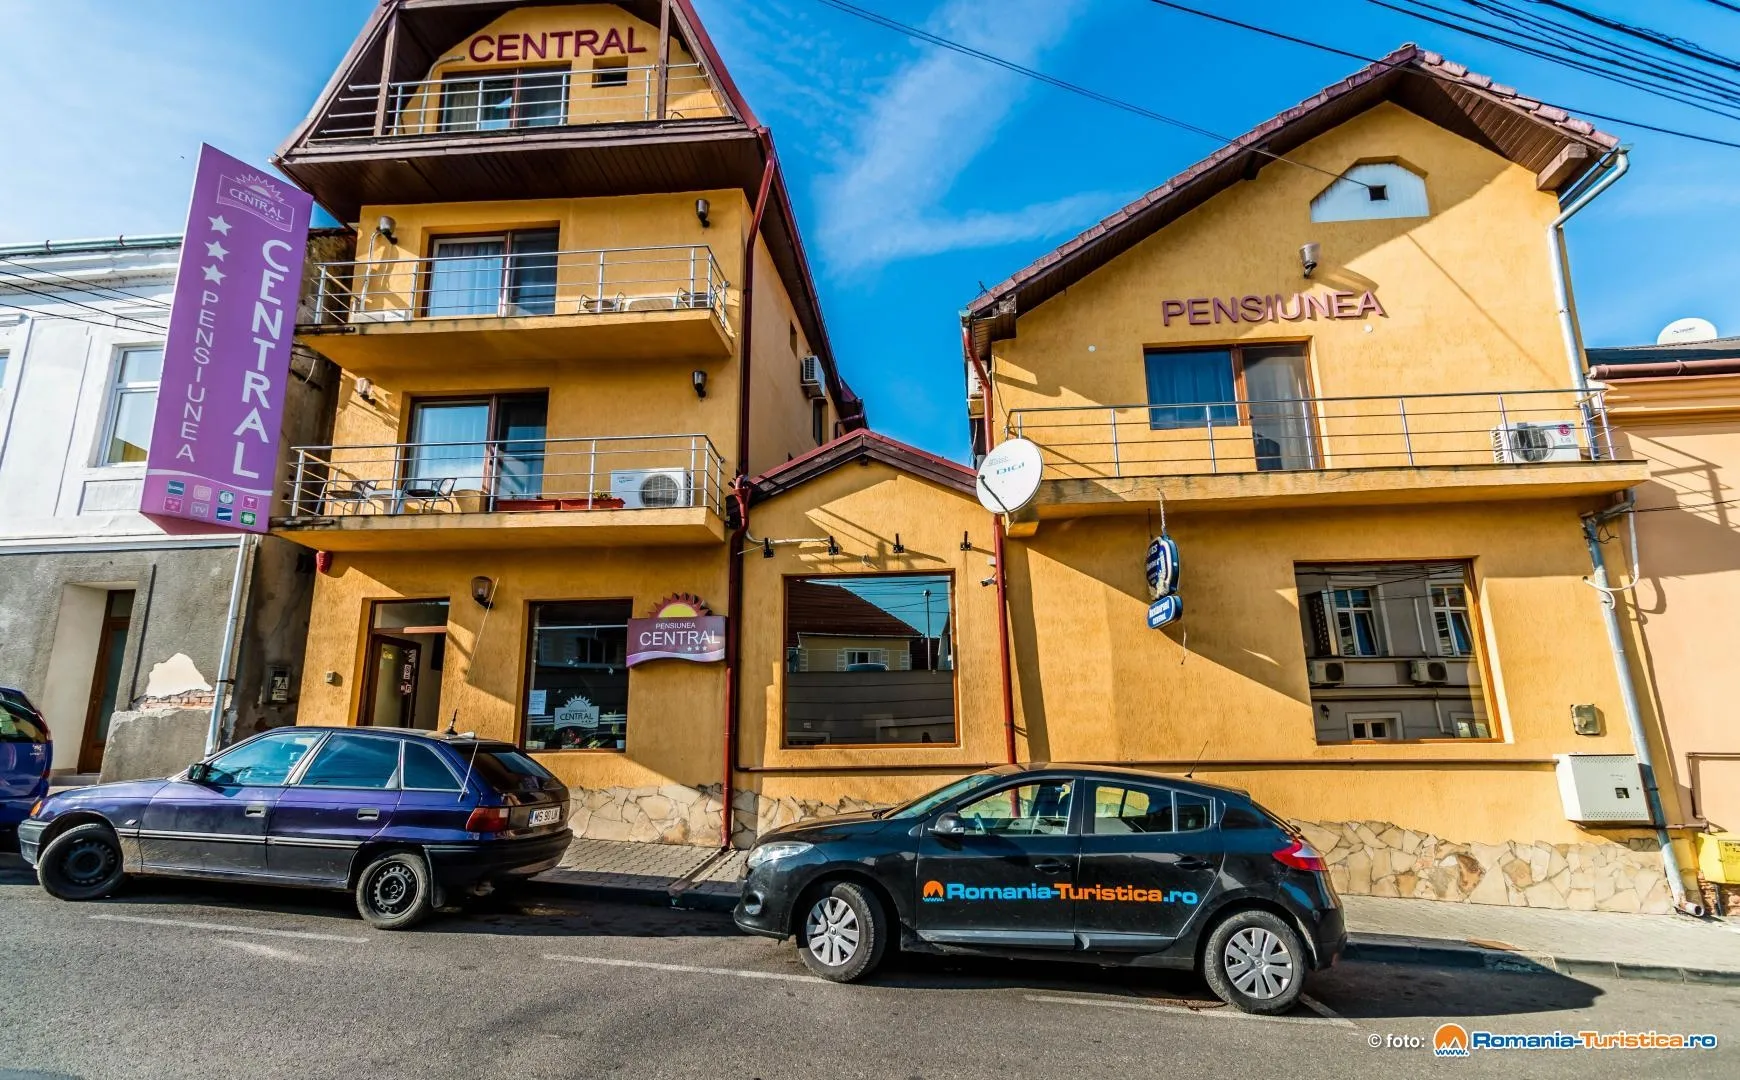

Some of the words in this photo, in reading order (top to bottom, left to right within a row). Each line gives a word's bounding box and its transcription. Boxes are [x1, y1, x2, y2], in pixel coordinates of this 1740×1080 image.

[469, 26, 647, 63] CENTRAL
[229, 188, 285, 220] CENTRAL
[1161, 290, 1384, 326] PENSIUNEA
[232, 239, 293, 479] CENTRAL
[176, 290, 219, 463] PENSIUNEA
[639, 630, 721, 646] CENTRAL
[655, 622, 696, 630] PENSIUNEA
[560, 713, 594, 721] CENTRAL
[946, 883, 1198, 904] Romania-Turistica.ro
